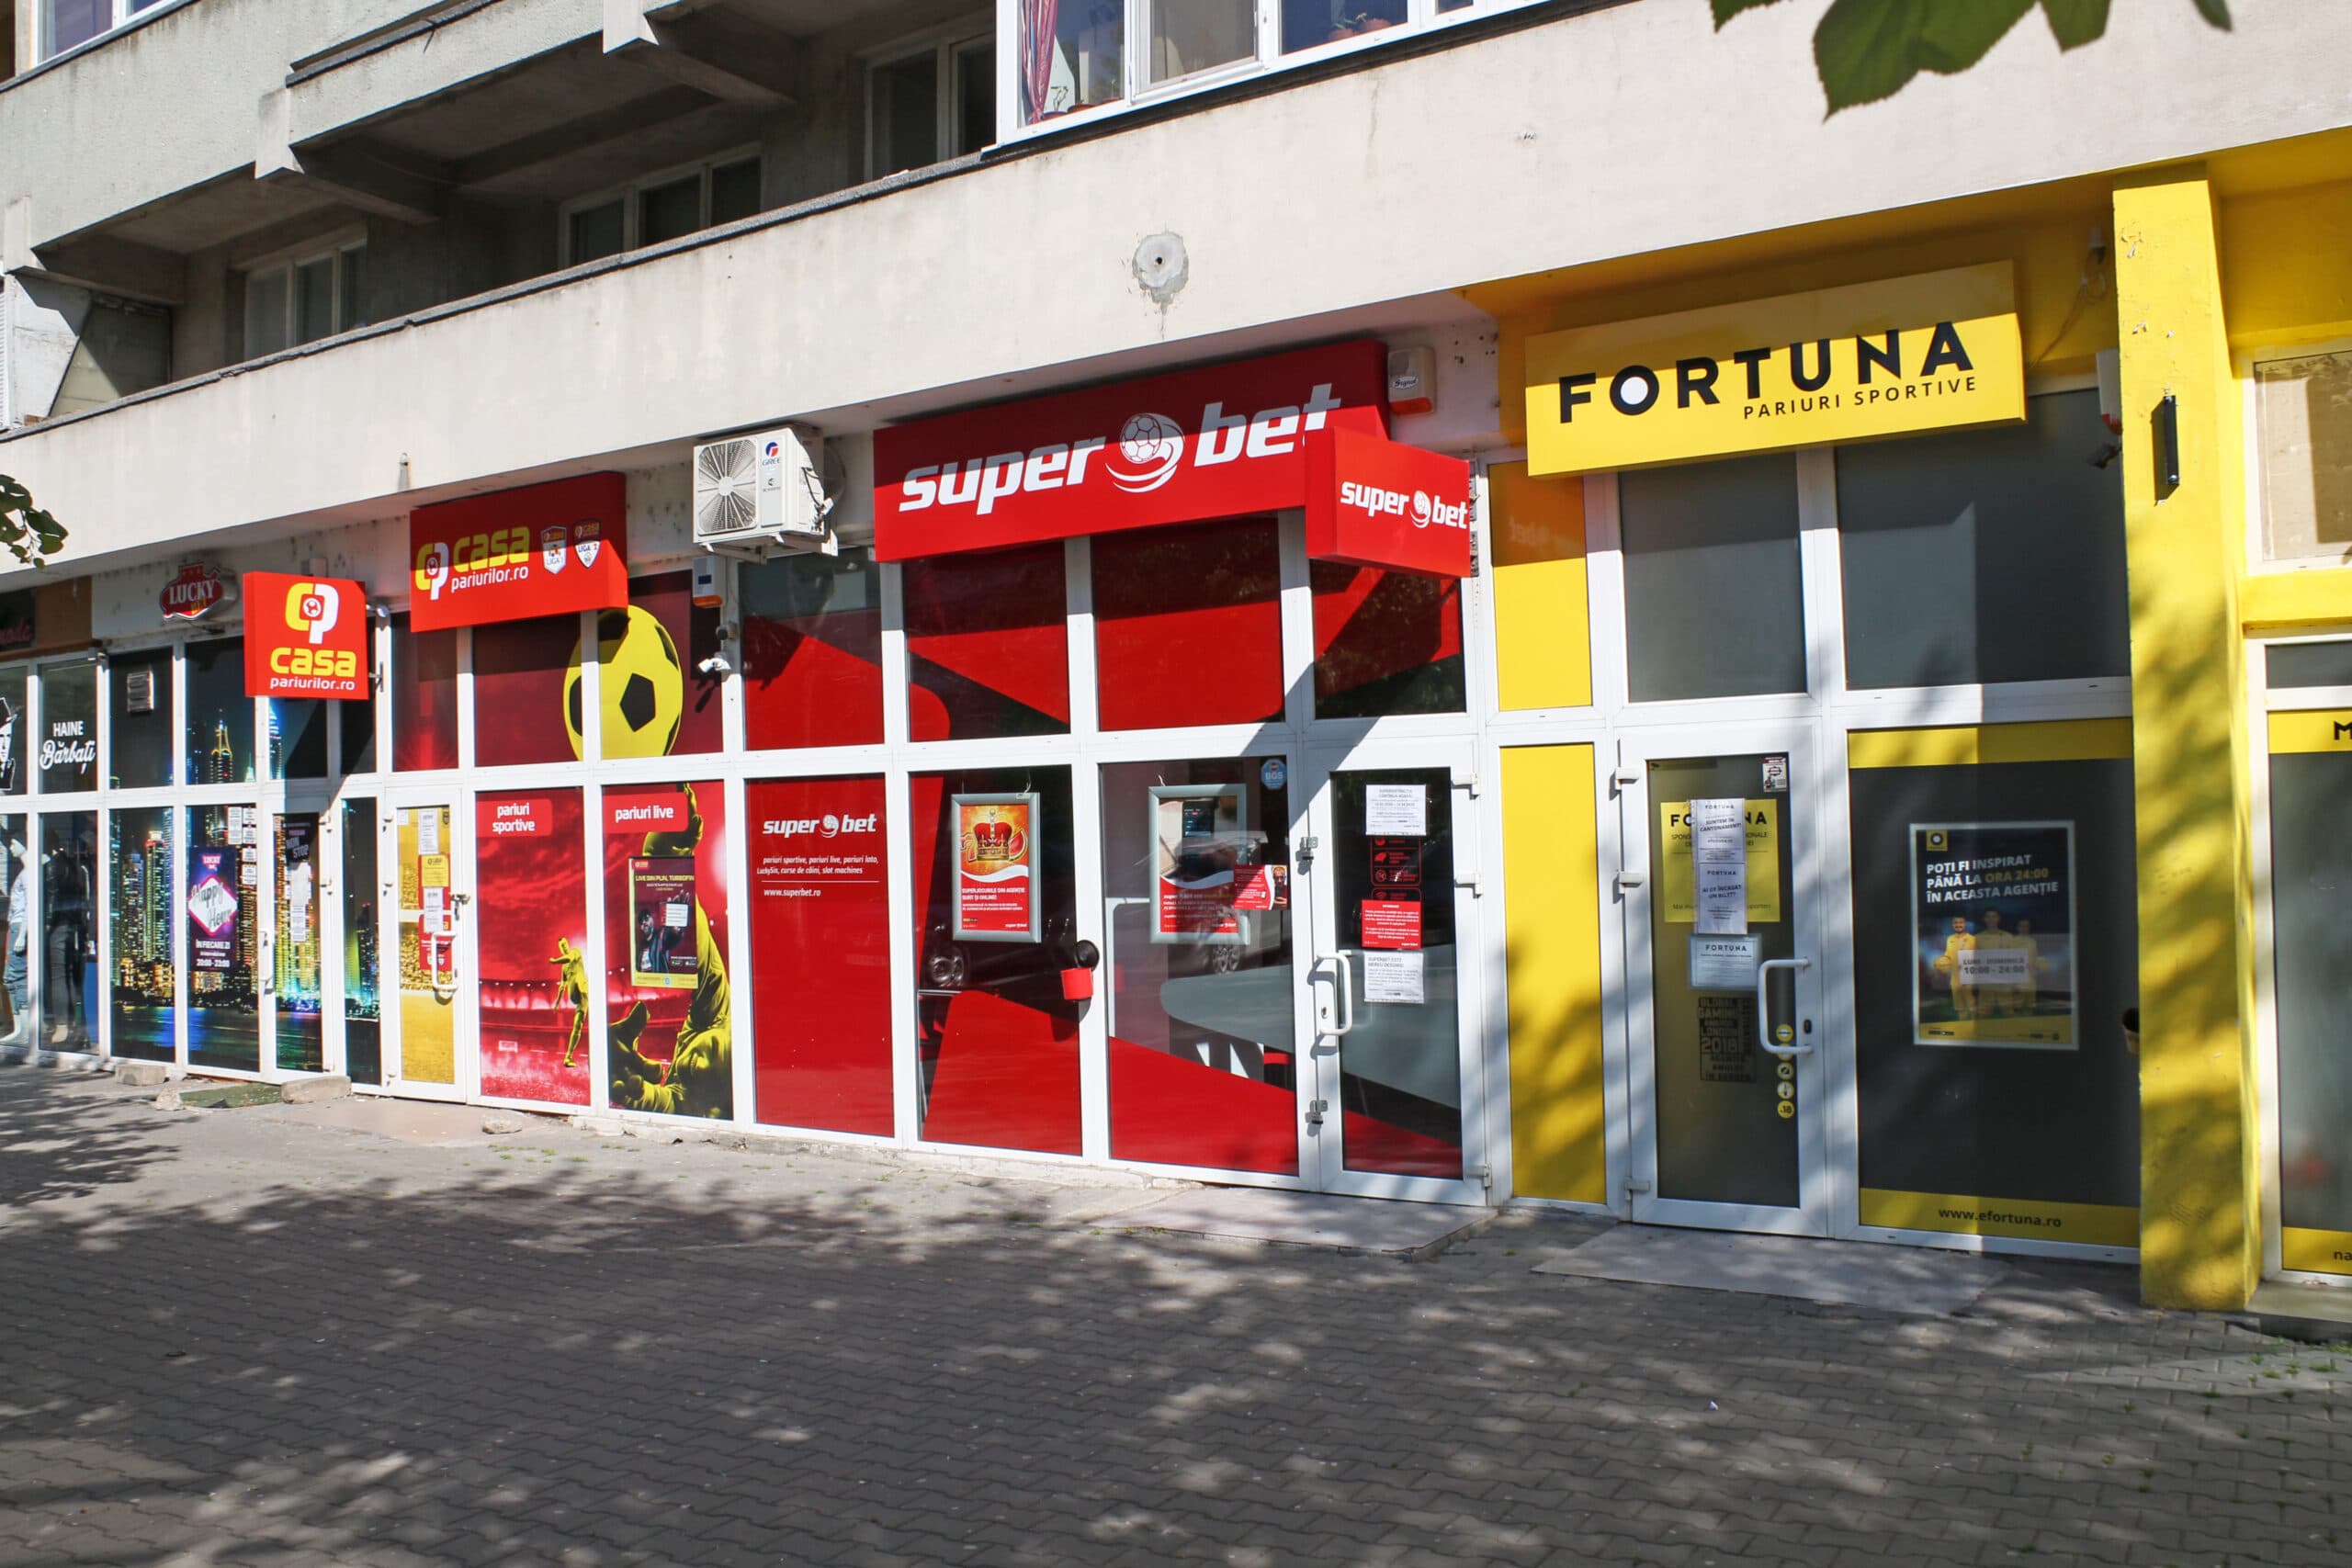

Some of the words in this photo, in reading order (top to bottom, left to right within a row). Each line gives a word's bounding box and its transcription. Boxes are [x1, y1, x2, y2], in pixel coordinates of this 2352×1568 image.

[1558, 321, 1974, 424] FORTUNA
[1744, 393, 1840, 420] PARIURI
[1854, 376, 1977, 406] SPORTIVE
[899, 435, 1105, 516] super
[1193, 383, 1341, 468] bet
[1340, 480, 1410, 518] super
[1431, 495, 1468, 529] bet
[453, 526, 530, 572] casa
[451, 566, 529, 593] pariurilor.ro
[169, 580, 215, 605] LUCKY
[270, 647, 356, 677] casa
[270, 677, 355, 690] pariurilor.ro
[53, 721, 84, 737] HAINE
[497, 802, 530, 818] pariuri
[615, 807, 650, 823] pariuri
[653, 805, 674, 818] live
[492, 819, 535, 834] sportive
[763, 819, 820, 838] super
[841, 814, 877, 832] bet
[1927, 861, 1956, 876] POȚI
[1959, 861, 1970, 872] FI
[1973, 854, 2032, 870] INSPIRAT
[1927, 873, 1962, 888] PÂNĂ
[1965, 874, 1982, 886] LA
[1984, 871, 2013, 884] ORA
[2015, 867, 2049, 880] 24:00
[1927, 890, 1941, 904] ÎN
[1944, 886, 2001, 901] ACEASTA
[2003, 881, 2059, 897] AGENȚIE
[1939, 1209, 2062, 1228] www.efortuna.ro
